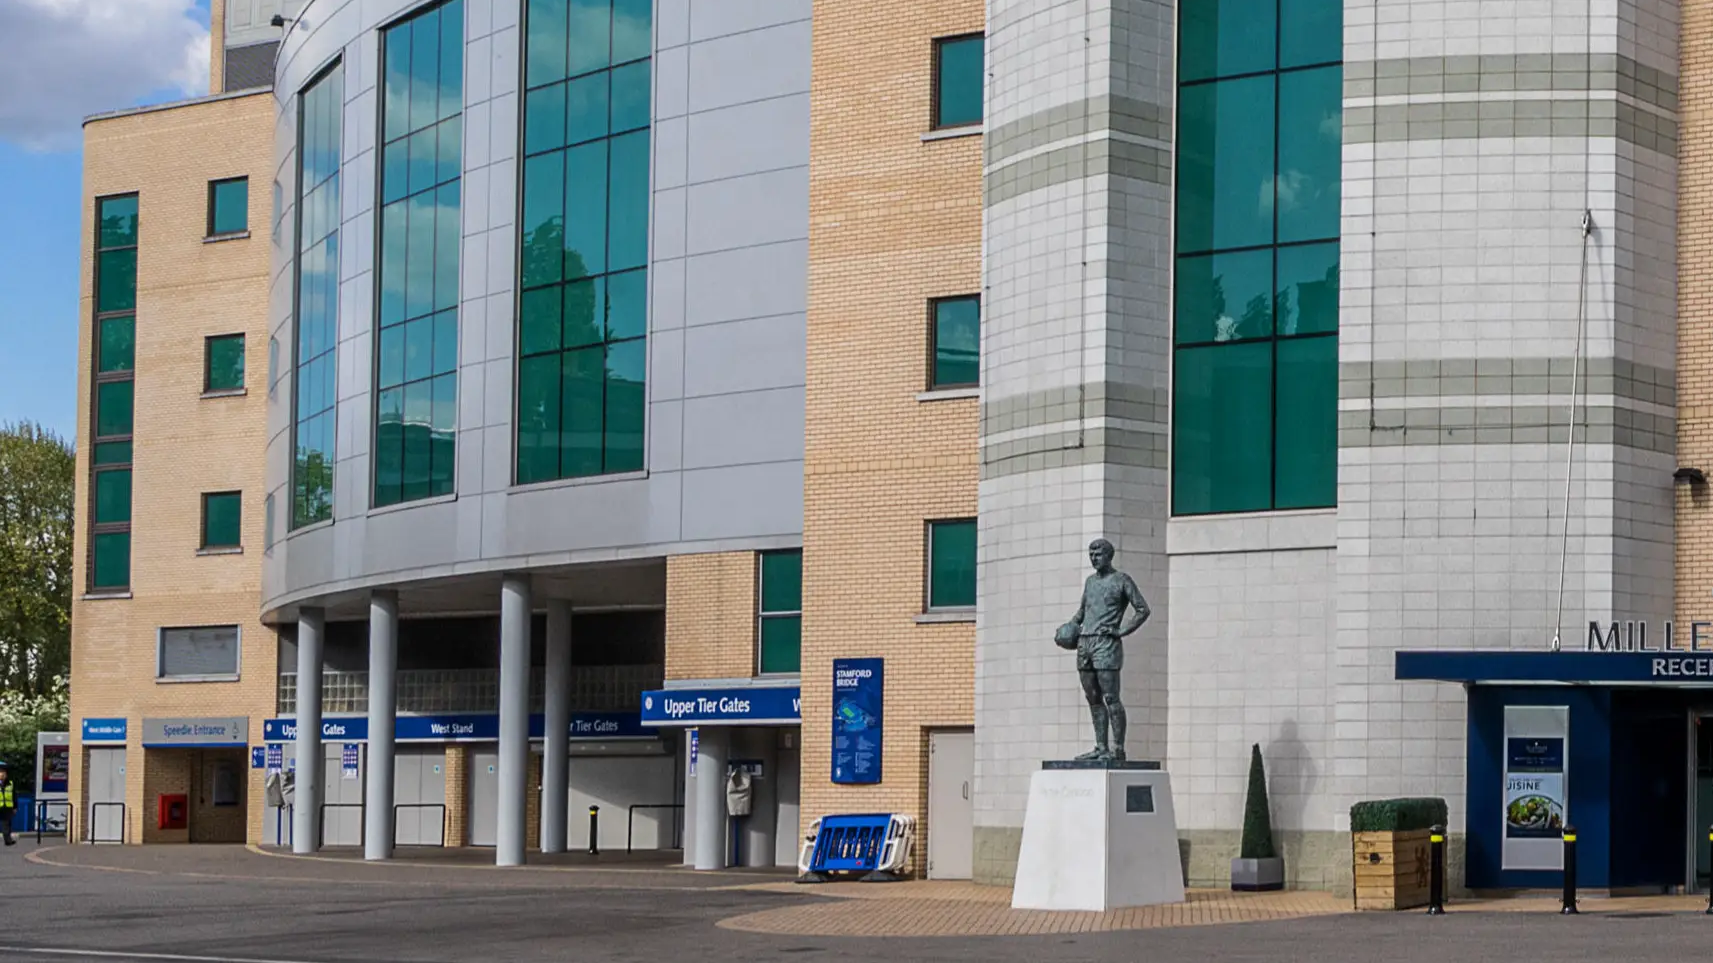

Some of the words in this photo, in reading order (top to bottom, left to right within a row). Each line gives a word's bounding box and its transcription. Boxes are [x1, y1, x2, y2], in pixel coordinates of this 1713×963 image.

[836, 669, 872, 679] STAMFORD
[836, 678, 859, 687] BRIDGE
[664, 698, 696, 718] Upper
[697, 698, 718, 713] Tier
[719, 697, 750, 713] Gates
[282, 724, 297, 738] Upp
[323, 723, 346, 735] Gates
[431, 723, 450, 734] West
[452, 723, 474, 734] Stand
[575, 720, 592, 732] Tier
[594, 719, 619, 732] Gates
[1507, 781, 1541, 791] UISINE
